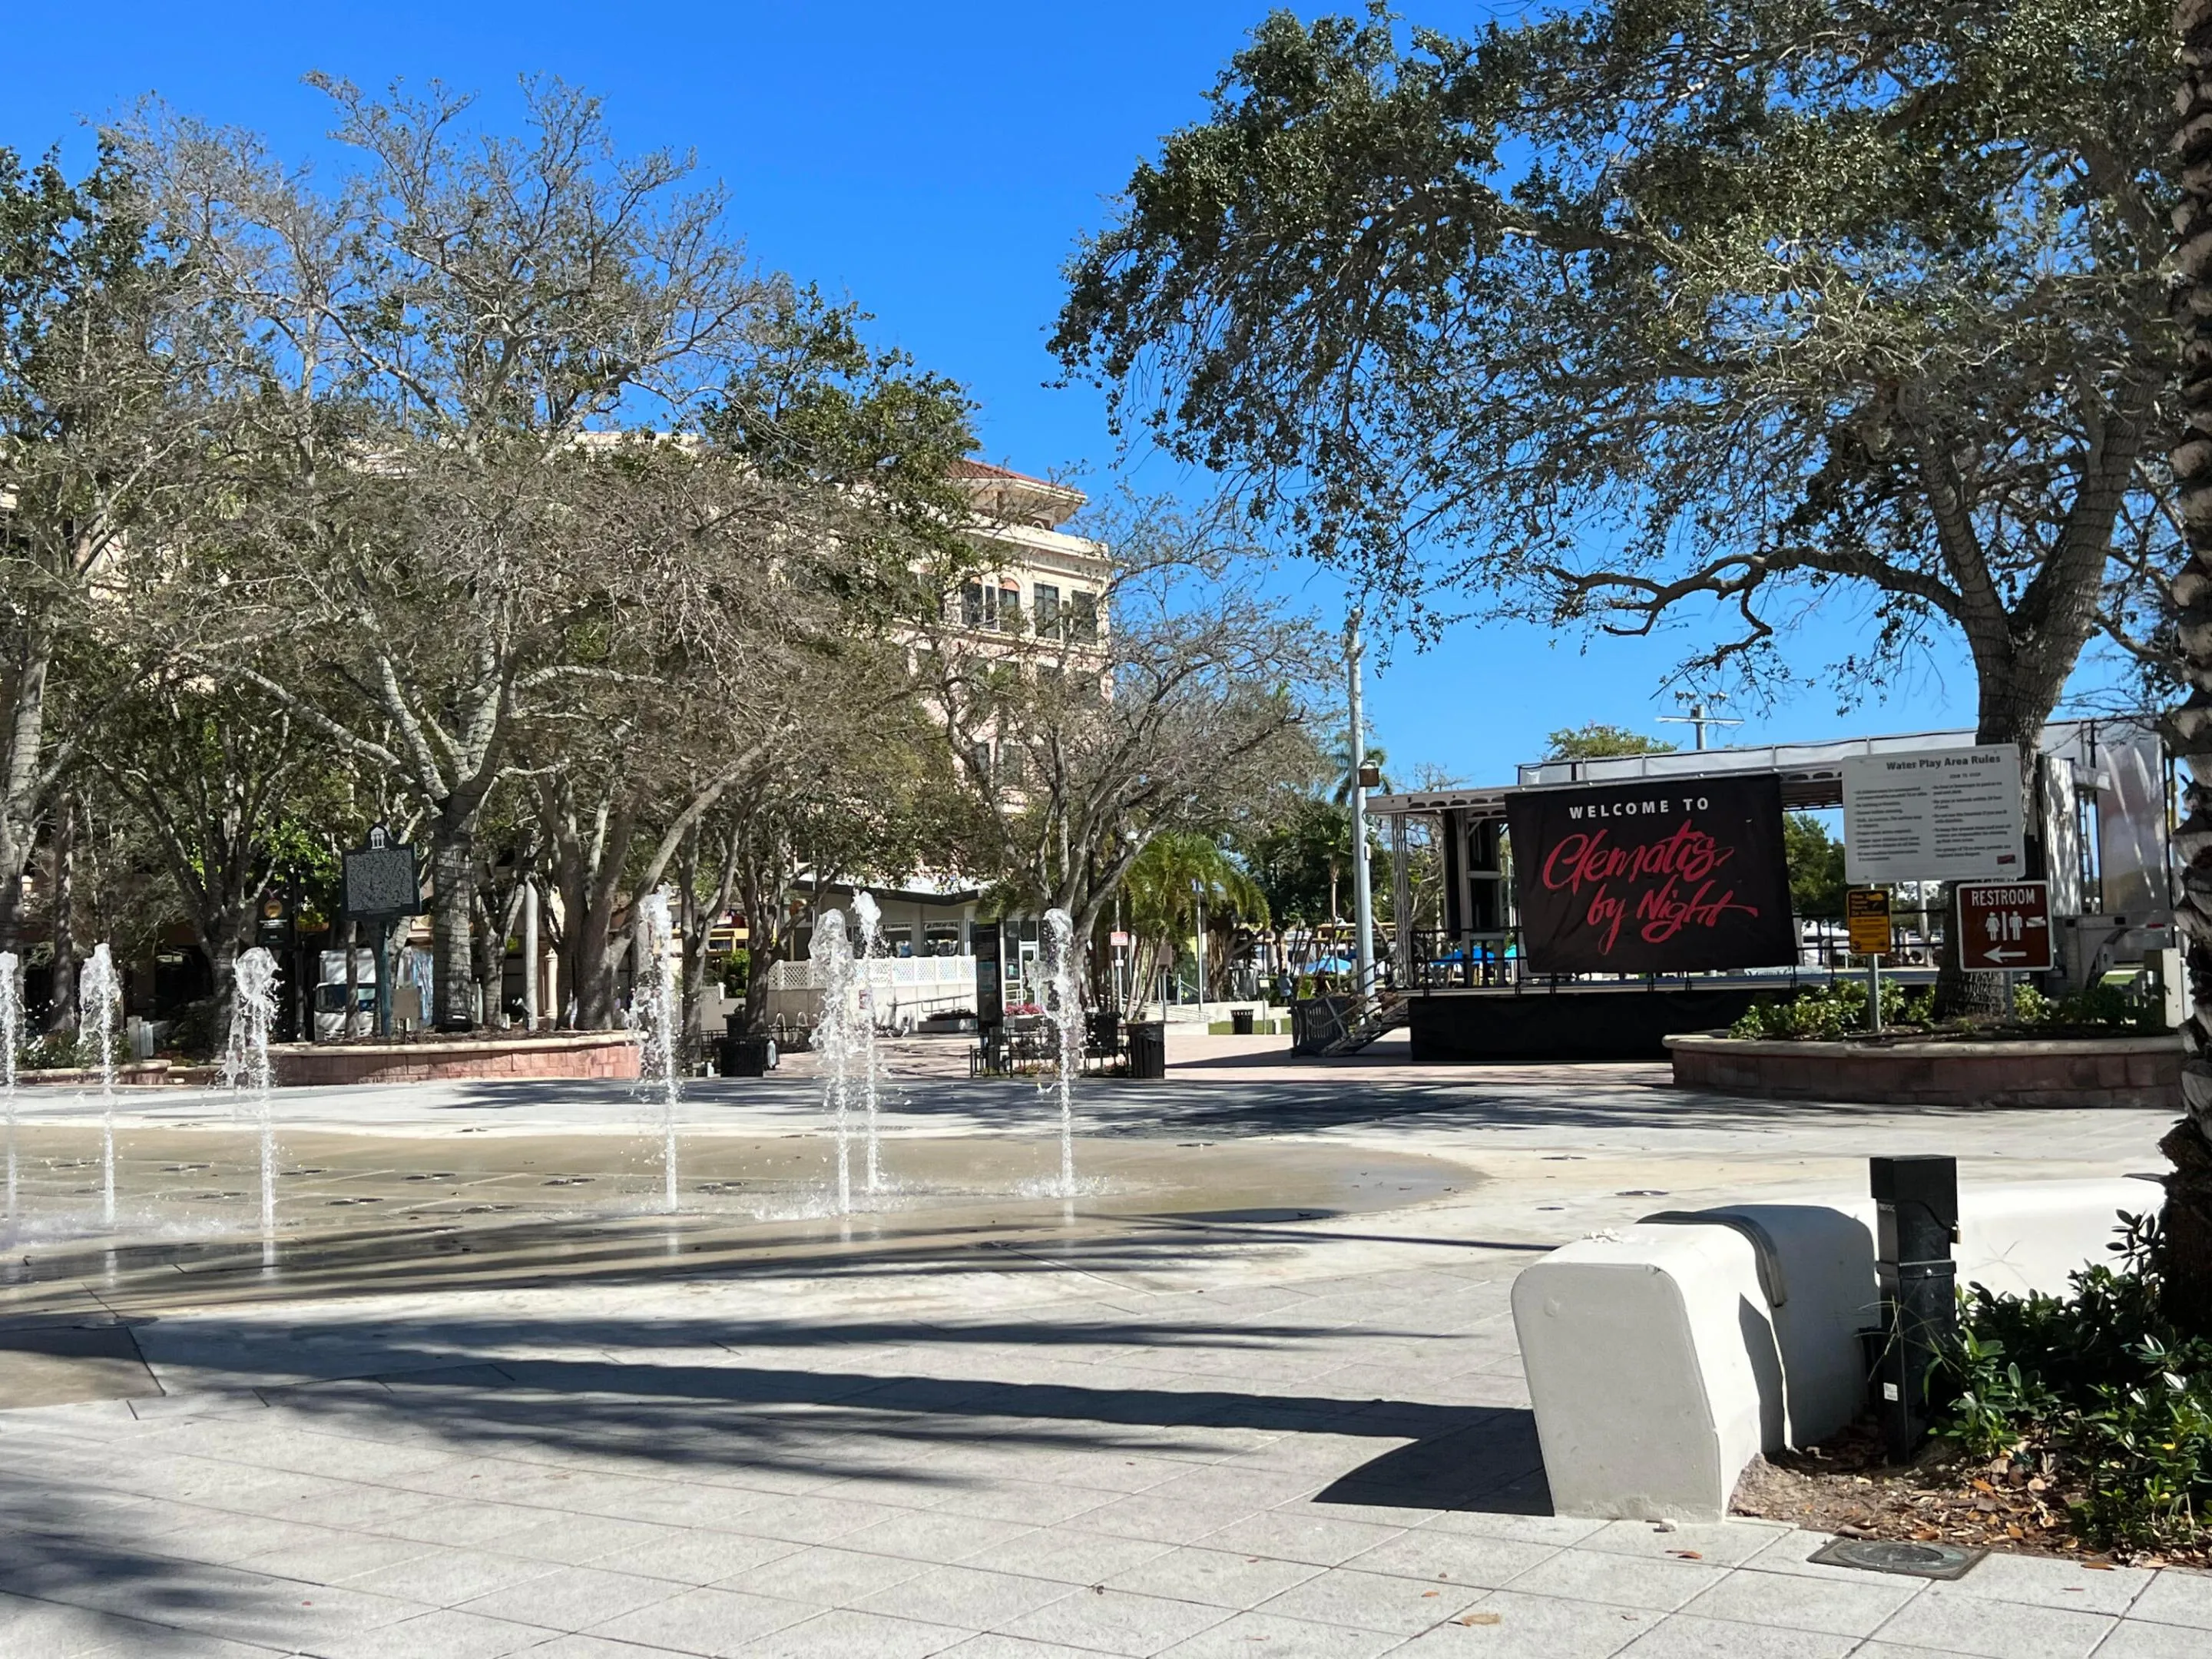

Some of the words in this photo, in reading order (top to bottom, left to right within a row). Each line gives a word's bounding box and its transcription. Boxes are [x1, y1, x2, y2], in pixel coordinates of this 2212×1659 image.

[1886, 761, 1917, 770] Water
[1919, 758, 1942, 770] Play
[1944, 757, 1969, 767] Area
[1971, 754, 2002, 765] Rules
[1570, 800, 1669, 819] WELCOME
[1683, 796, 1710, 811] TO
[1543, 820, 1734, 894] Clematis
[1971, 888, 2035, 907] RESTROOM
[1587, 884, 1627, 955] by
[1637, 875, 1758, 942] Night
